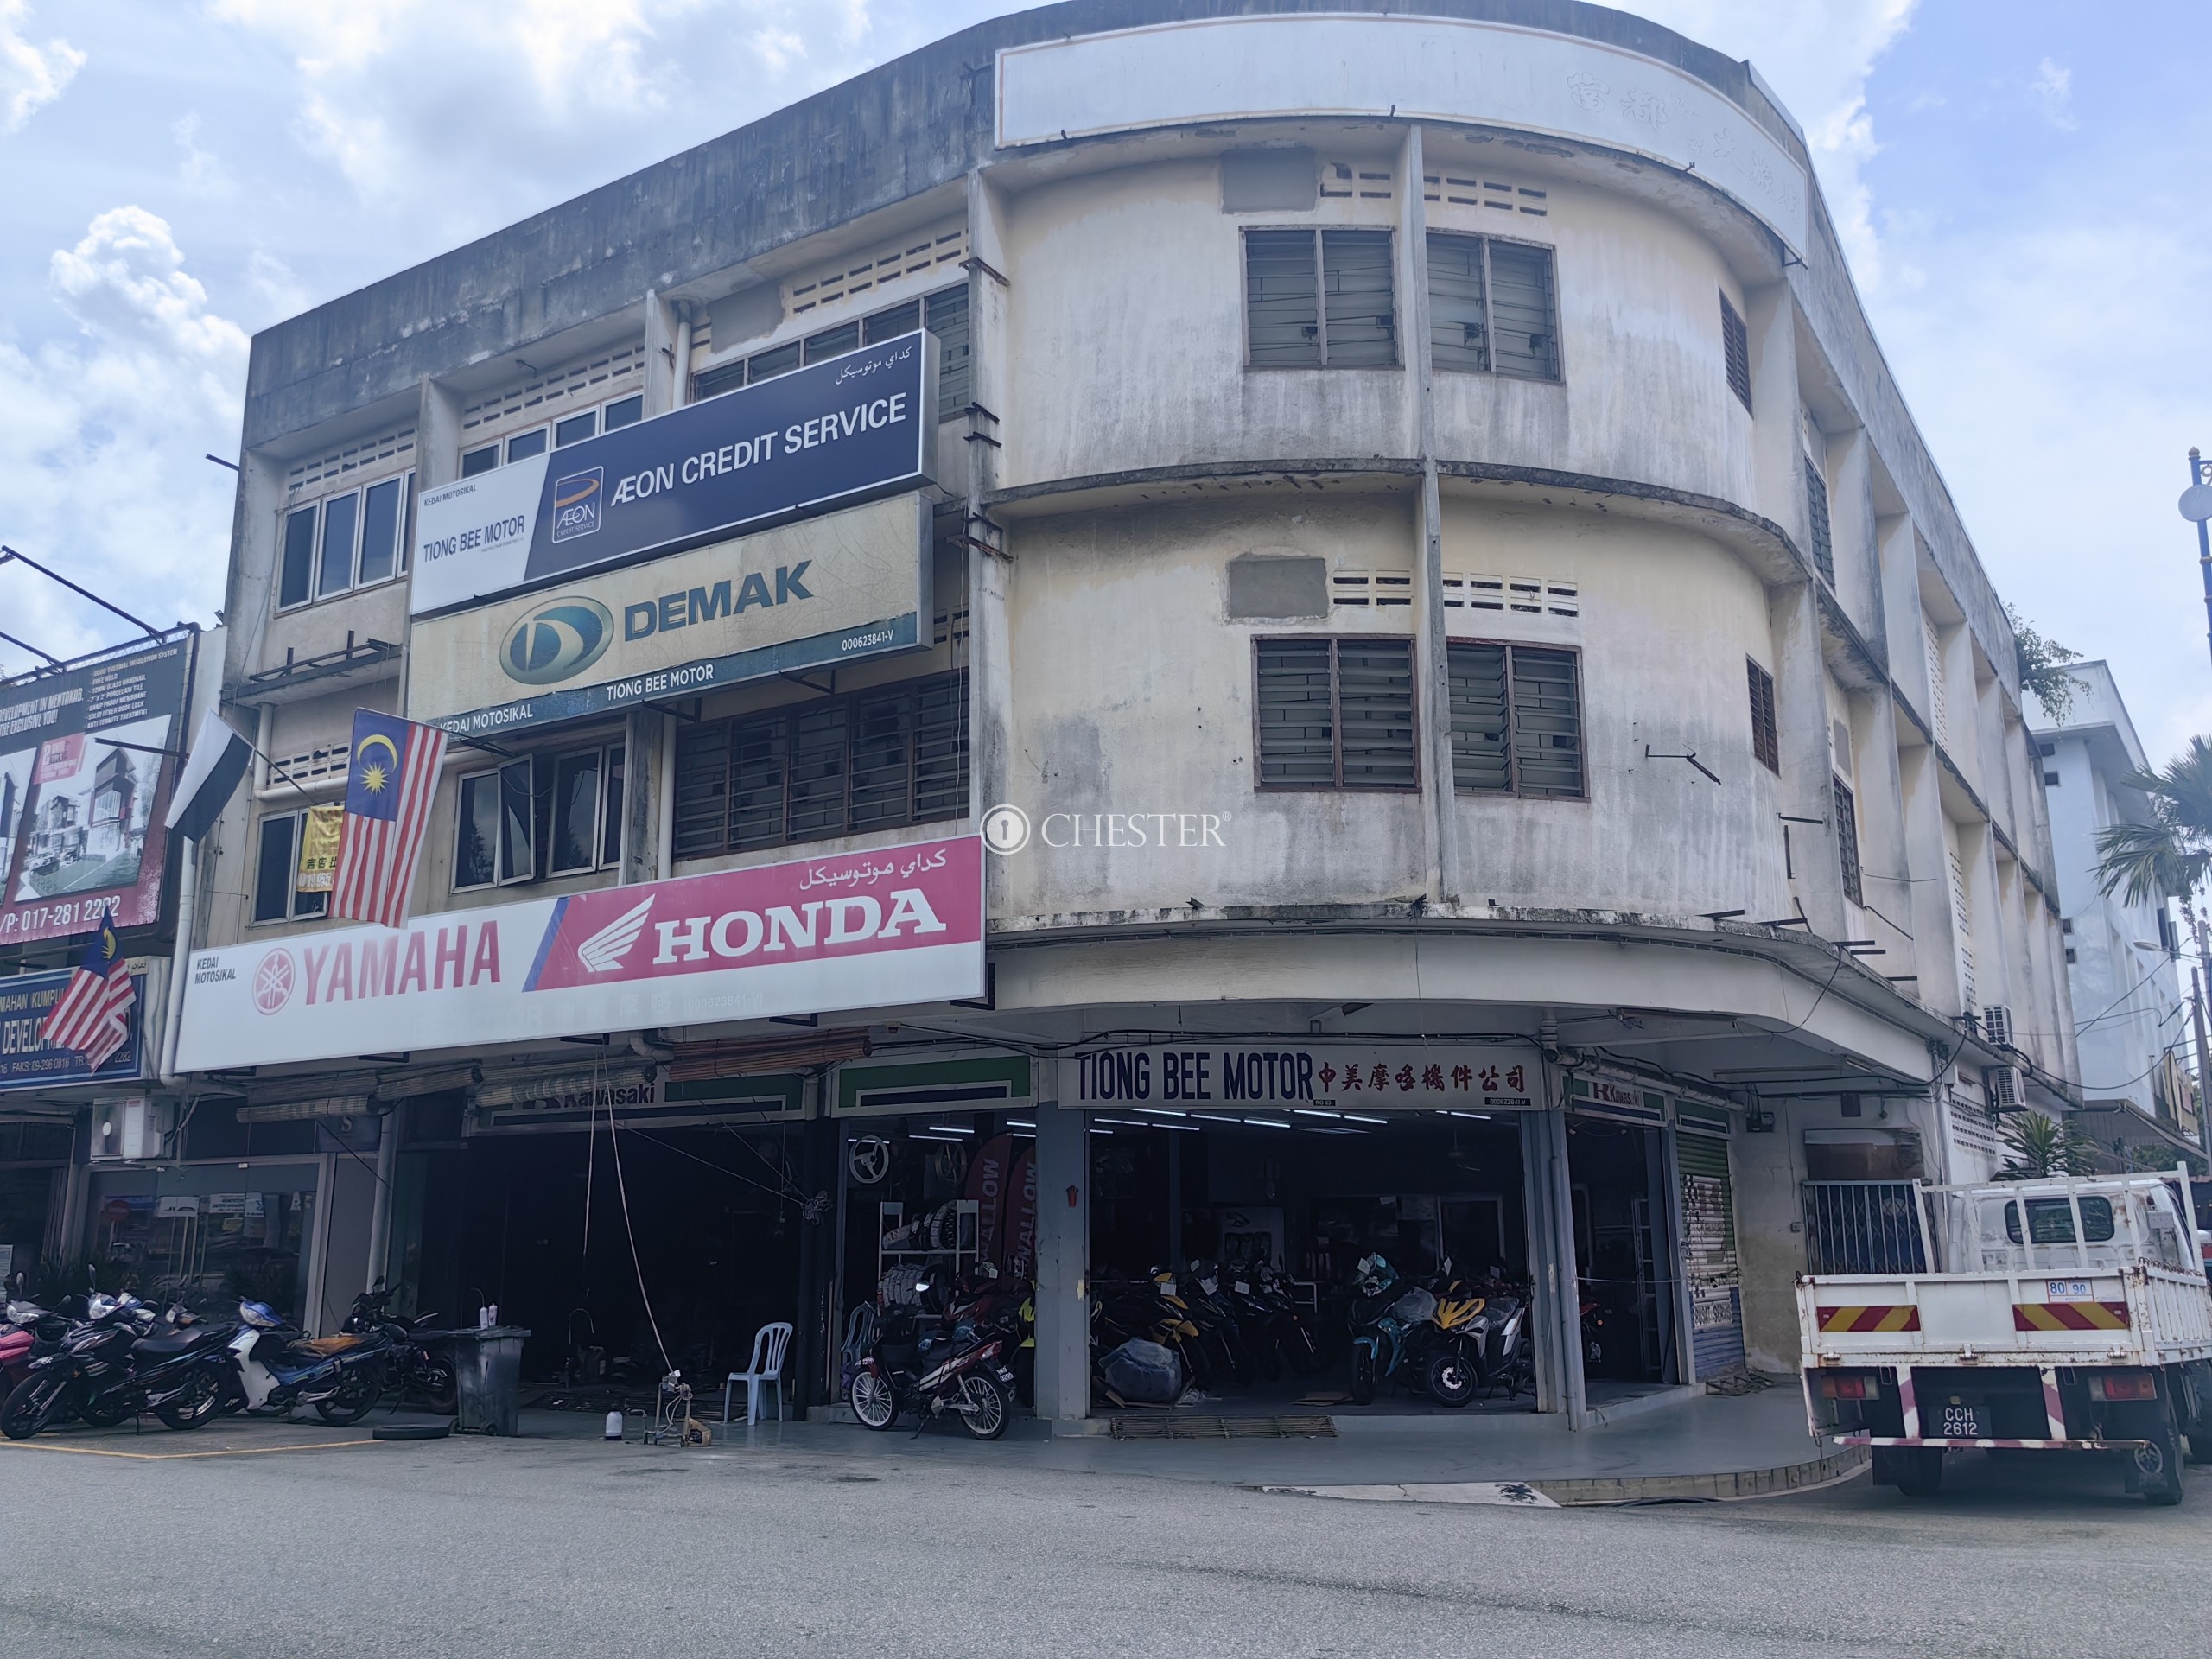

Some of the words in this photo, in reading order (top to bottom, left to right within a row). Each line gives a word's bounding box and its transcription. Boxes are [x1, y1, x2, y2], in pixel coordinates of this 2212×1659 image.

[682, 432, 779, 484] CREDIT
[784, 392, 906, 454] SERVICE
[424, 495, 442, 506] KEDAI
[442, 484, 476, 500] MOTOSIKAL
[557, 526, 575, 537] CREDIT
[575, 521, 595, 532] SERVICE
[423, 536, 457, 563] TIONG
[460, 528, 481, 552] BEE
[485, 515, 525, 544] MOTOR
[625, 559, 814, 642] DEMAK
[842, 630, 894, 651] 000623841-V
[107, 662, 129, 673] THERMAL
[130, 655, 157, 667] INSULATION
[158, 648, 178, 659] SYSTEM
[92, 677, 105, 685] FREE
[106, 680, 122, 690] GLASS
[106, 687, 132, 698] PORCELAIN
[133, 683, 143, 692] TILE
[607, 680, 642, 701] TIONG
[645, 674, 667, 693] BEE
[671, 664, 714, 688] MOTOR
[40, 696, 48, 711] IN
[103, 708, 118, 716] LEVER
[131, 701, 144, 709] LOCK
[104, 699, 119, 709] PROOF
[119, 691, 147, 703] MEMBRANE
[99, 716, 119, 726] TERMITE
[120, 709, 149, 721] TREATMENT
[440, 718, 470, 734] KEDAI
[473, 703, 533, 729] MOTOSIKAL
[22, 902, 80, 931] 017-281
[653, 888, 946, 964] HONDA
[197, 957, 219, 970] KEDAI
[304, 920, 500, 1005] YAMAHA
[195, 968, 236, 984] MOTOSIKAL
[12, 1061, 30, 1073] FAKS:
[1075, 1052, 1150, 1100] TIONG
[1163, 1052, 1211, 1100] BEE
[1224, 1052, 1313, 1100] MOTOR
[564, 1083, 655, 1107] Kawasaki
[1609, 1083, 1642, 1107] Kawasaki
[2050, 1282, 2065, 1294] 80
[2072, 1284, 2087, 1294] 90
[1945, 1408, 1974, 1421] CCH
[1943, 1421, 1978, 1436] 2612
